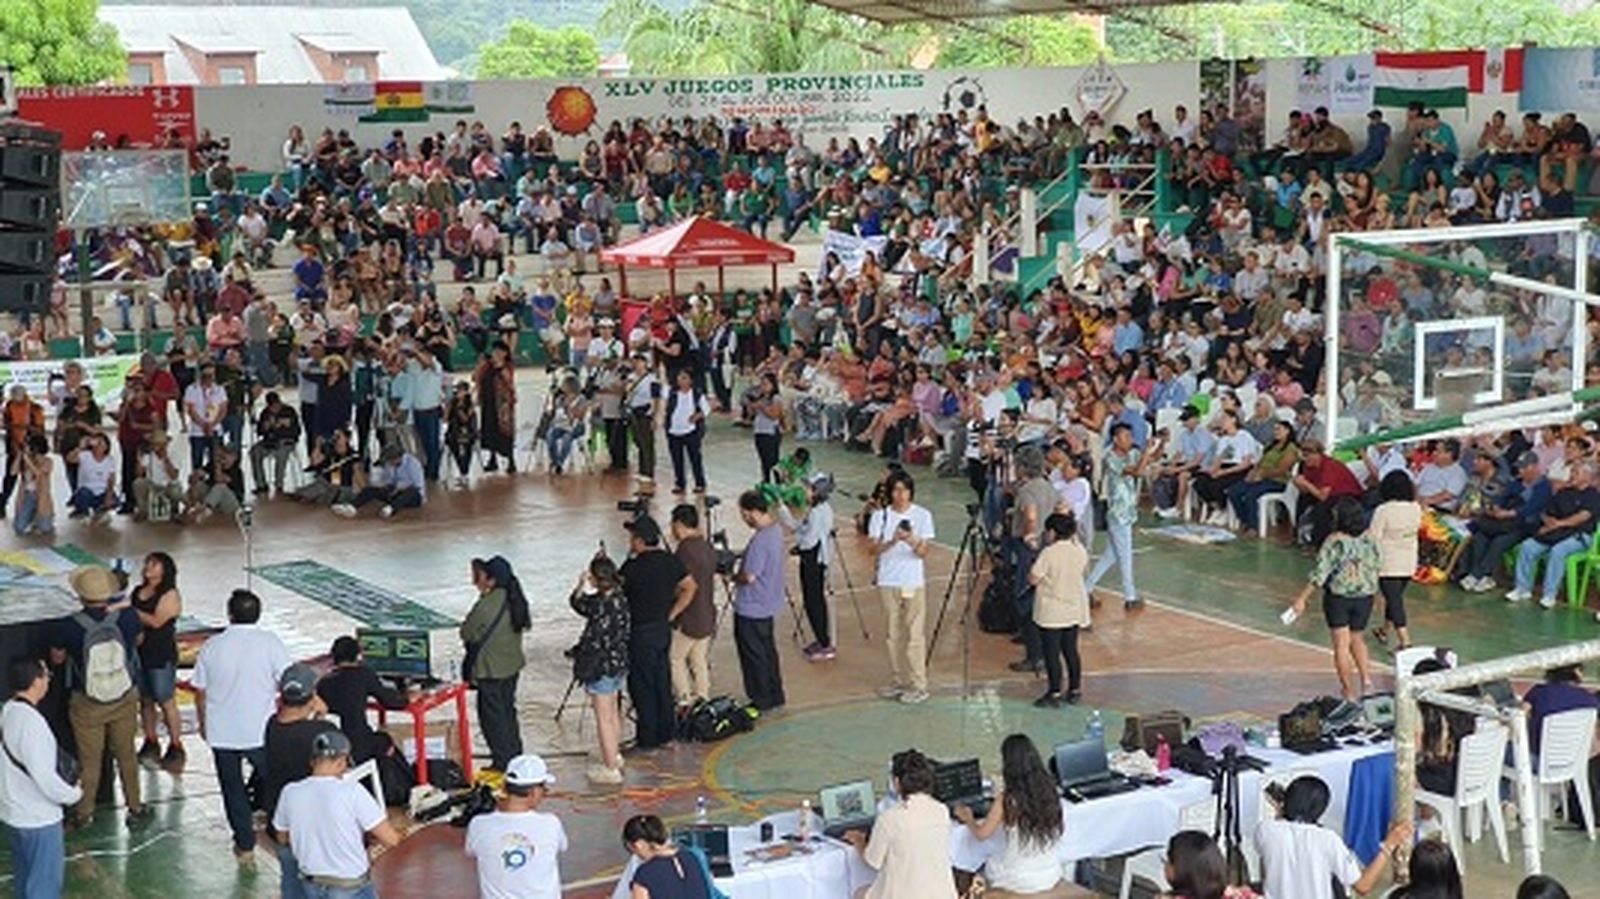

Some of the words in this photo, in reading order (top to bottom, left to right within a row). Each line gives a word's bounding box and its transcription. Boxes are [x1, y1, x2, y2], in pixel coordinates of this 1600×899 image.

[605, 81, 655, 96] XLV
[664, 79, 753, 95] JUEGOS
[767, 74, 924, 92] PROVINCIALES
